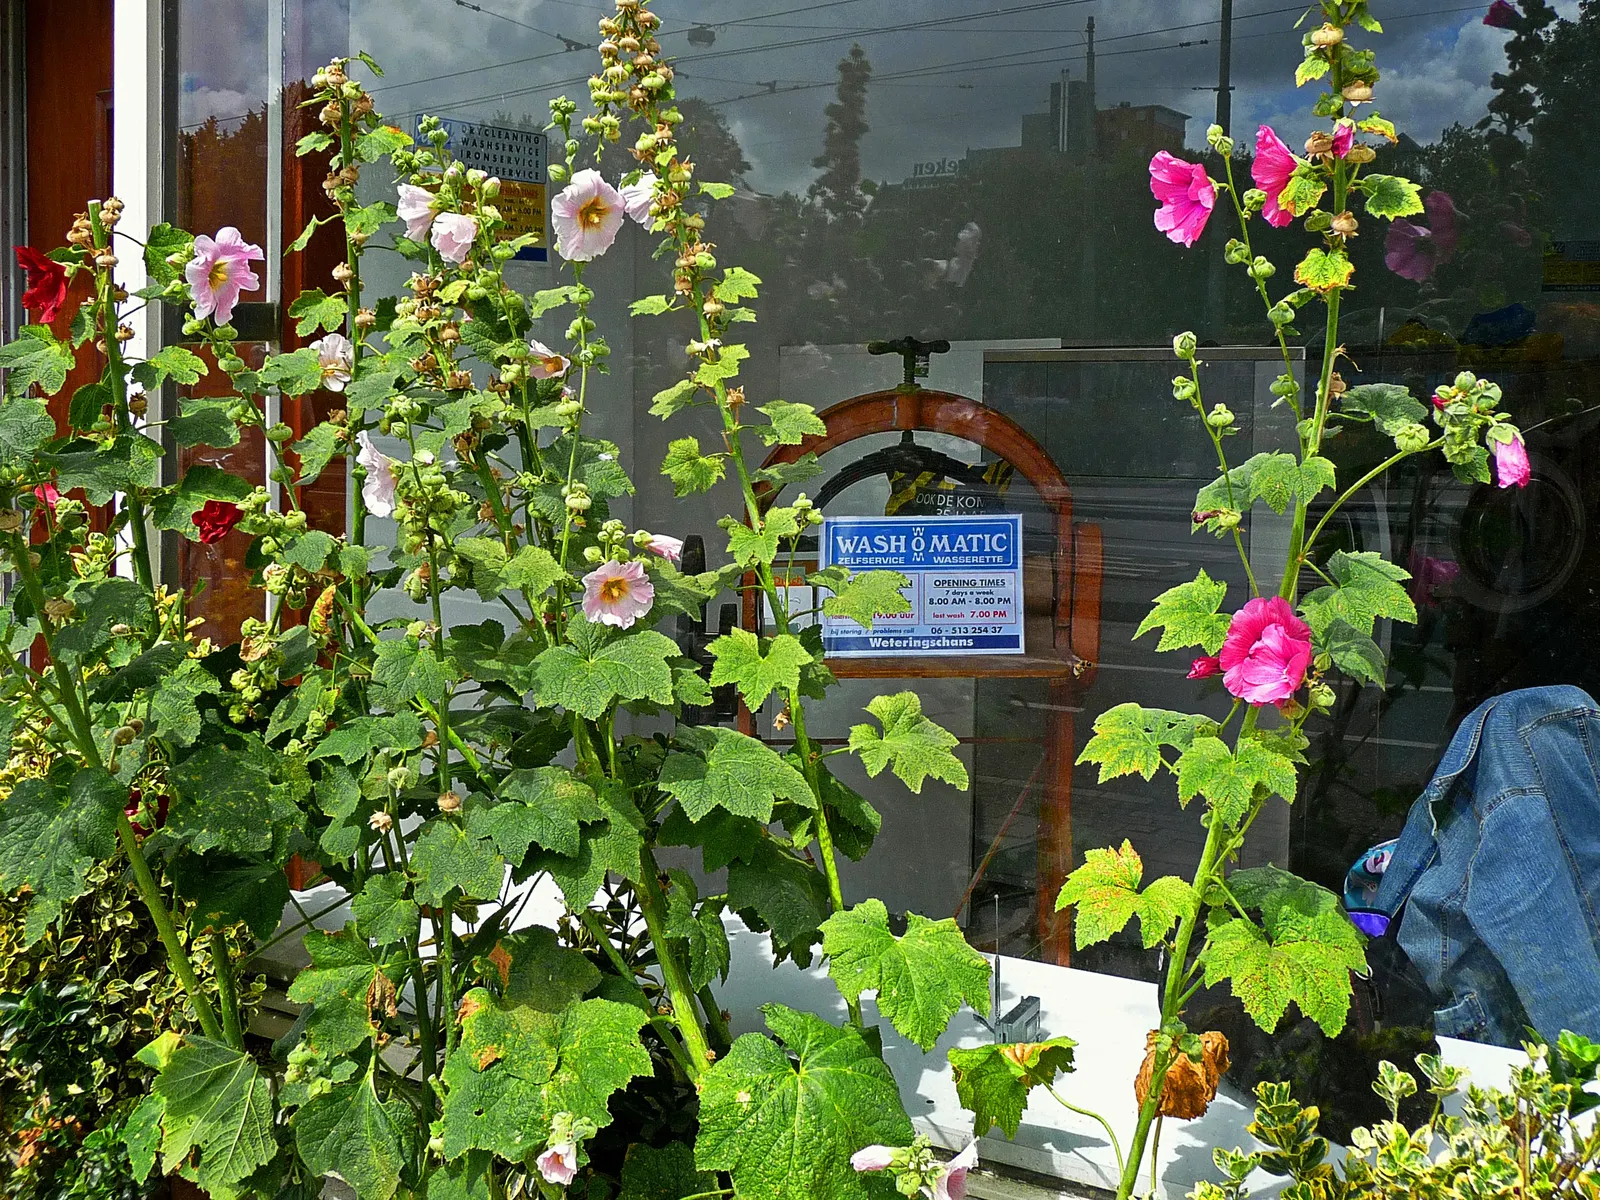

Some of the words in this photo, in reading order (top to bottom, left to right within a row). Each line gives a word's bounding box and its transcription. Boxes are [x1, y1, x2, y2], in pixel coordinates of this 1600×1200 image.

[461, 125, 540, 144] DRYCLEANING
[461, 137, 540, 157] WASHSERVICE
[460, 149, 540, 169] IRONSERVICE
[466, 162, 540, 180] HIRTSERVICE
[916, 493, 935, 505] OOK
[937, 494, 954, 507] DE
[836, 534, 906, 554] WASH
[928, 533, 1008, 553] MATIC
[837, 556, 905, 565] ZELFSERVICE
[933, 555, 1003, 564] WASSERETTE
[933, 579, 977, 587] OPENING
[980, 578, 1006, 587] TIMES
[952, 589, 968, 597] days
[928, 597, 949, 606] 8.00
[951, 597, 966, 605] AM
[974, 597, 995, 605] 8.00
[997, 597, 1011, 605] PM
[970, 610, 991, 618] 7.00
[993, 610, 1007, 618] PM
[872, 627, 902, 636] problems
[931, 626, 943, 635] 06
[951, 626, 969, 635] 513
[971, 626, 989, 634] 254
[991, 626, 1003, 634] 37
[869, 637, 974, 649] Weteringschans
